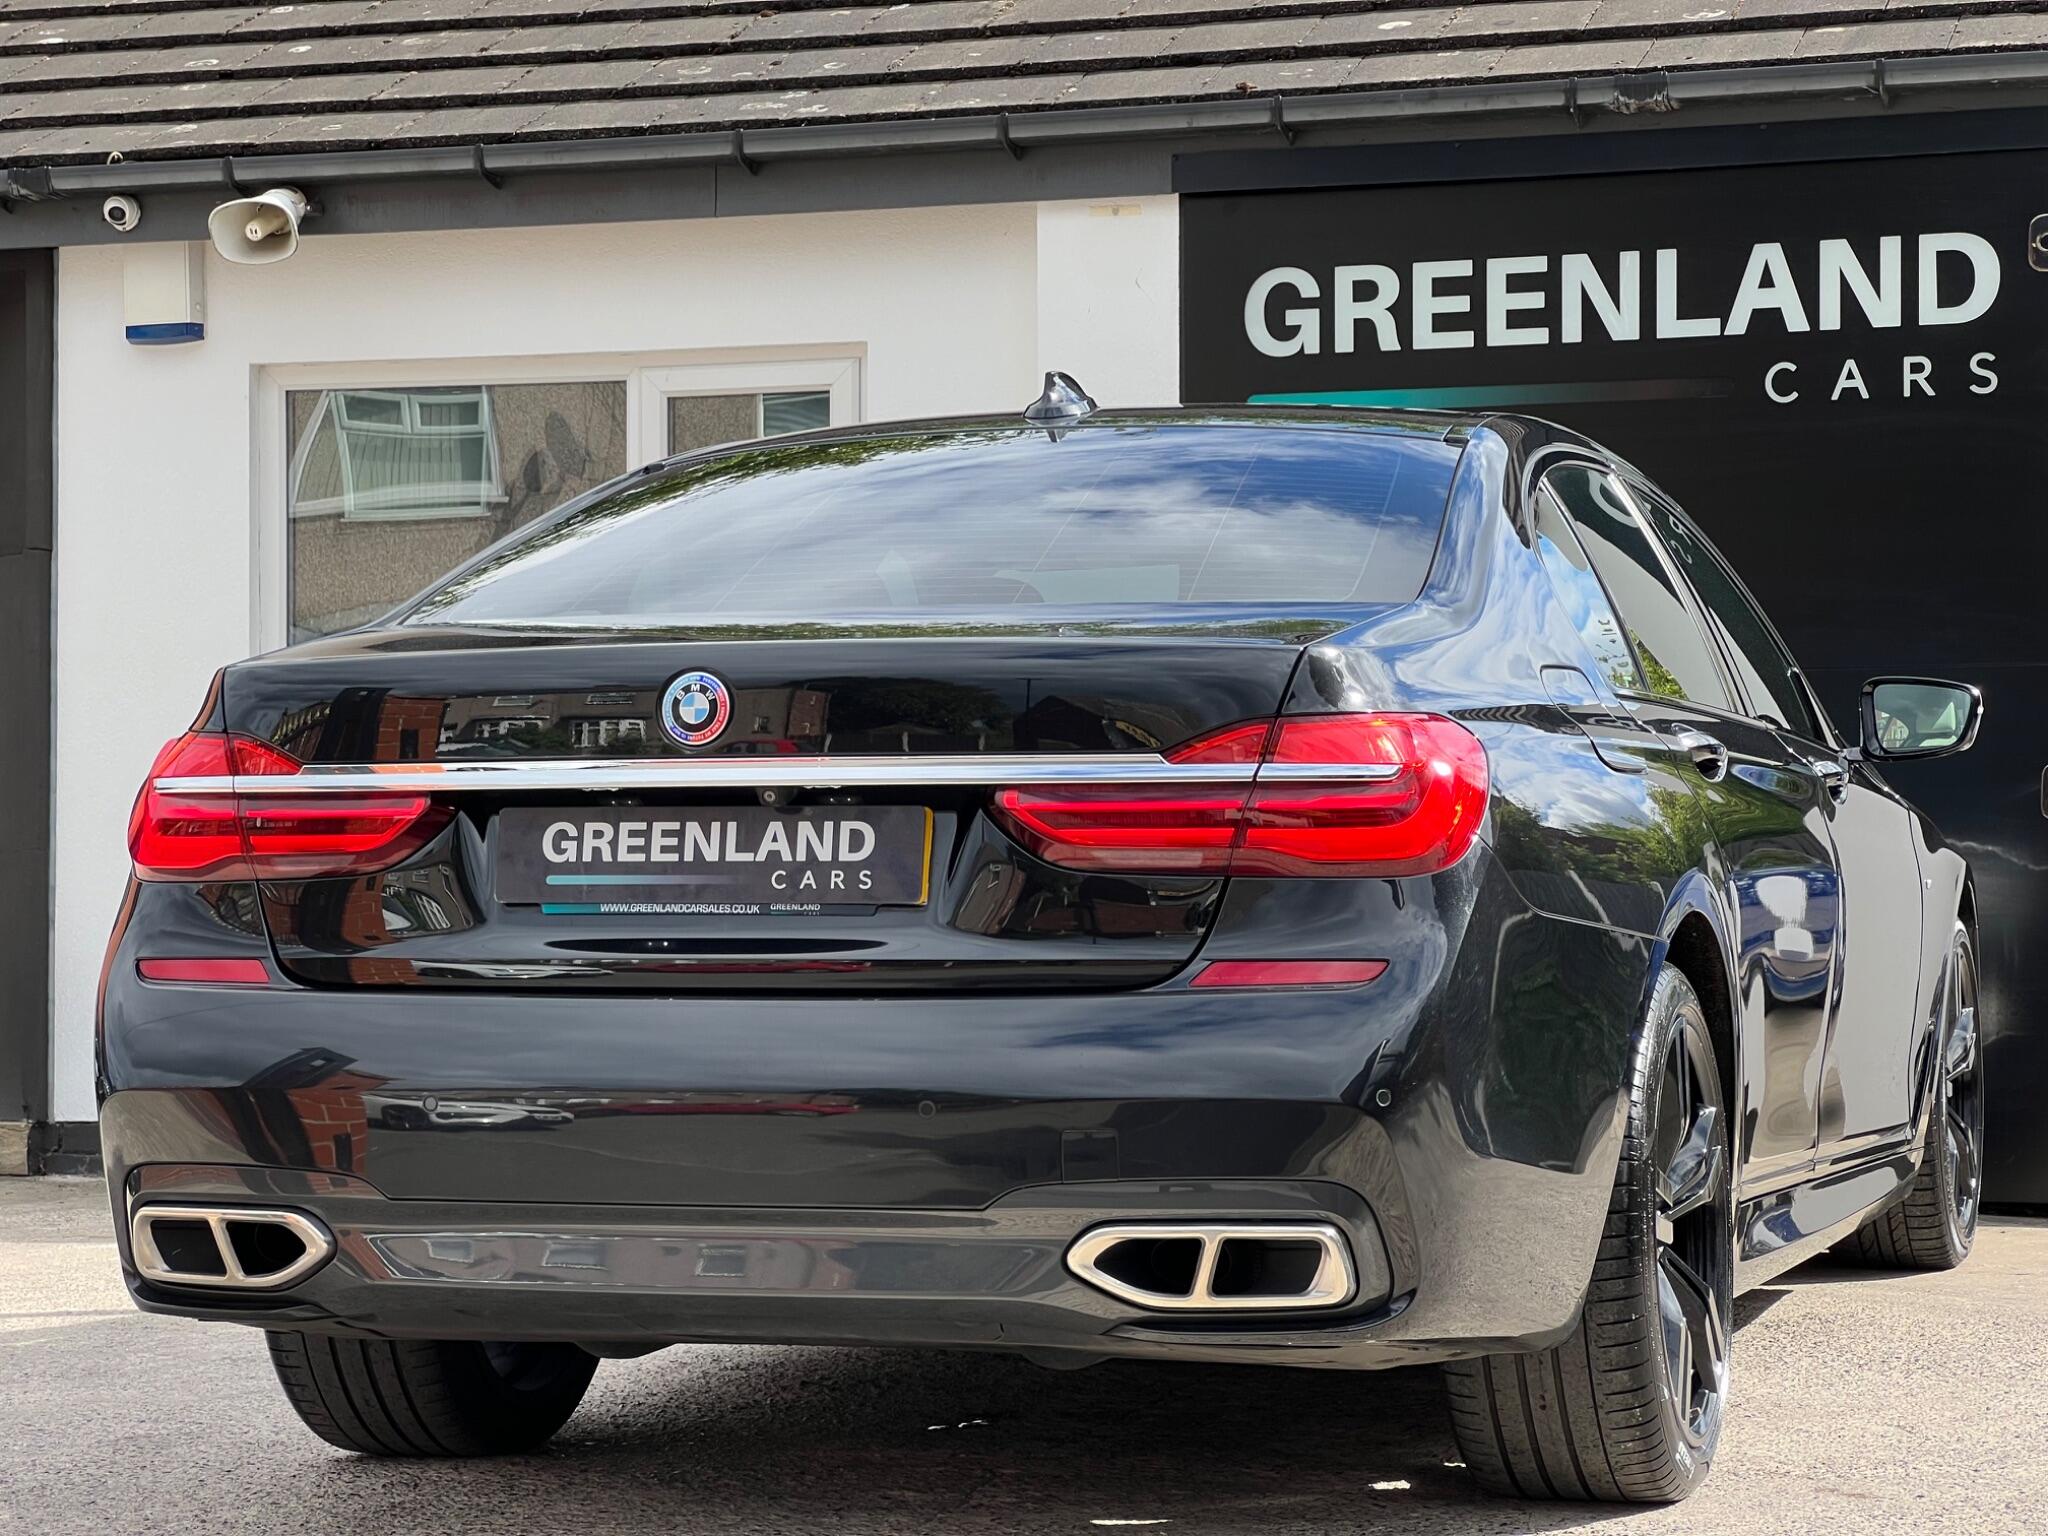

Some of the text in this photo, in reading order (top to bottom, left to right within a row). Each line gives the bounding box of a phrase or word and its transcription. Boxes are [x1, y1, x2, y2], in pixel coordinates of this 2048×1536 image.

[1244, 232, 2001, 358] GREENLAND
[1764, 351, 1999, 404] CARS
[676, 683, 716, 701] BMW
[542, 820, 876, 863] GREENLAND
[771, 869, 872, 890] CARS
[600, 903, 760, 914] WWW.GREENLANDCARSALES.CO.UK
[770, 903, 821, 911] GREENLAND
